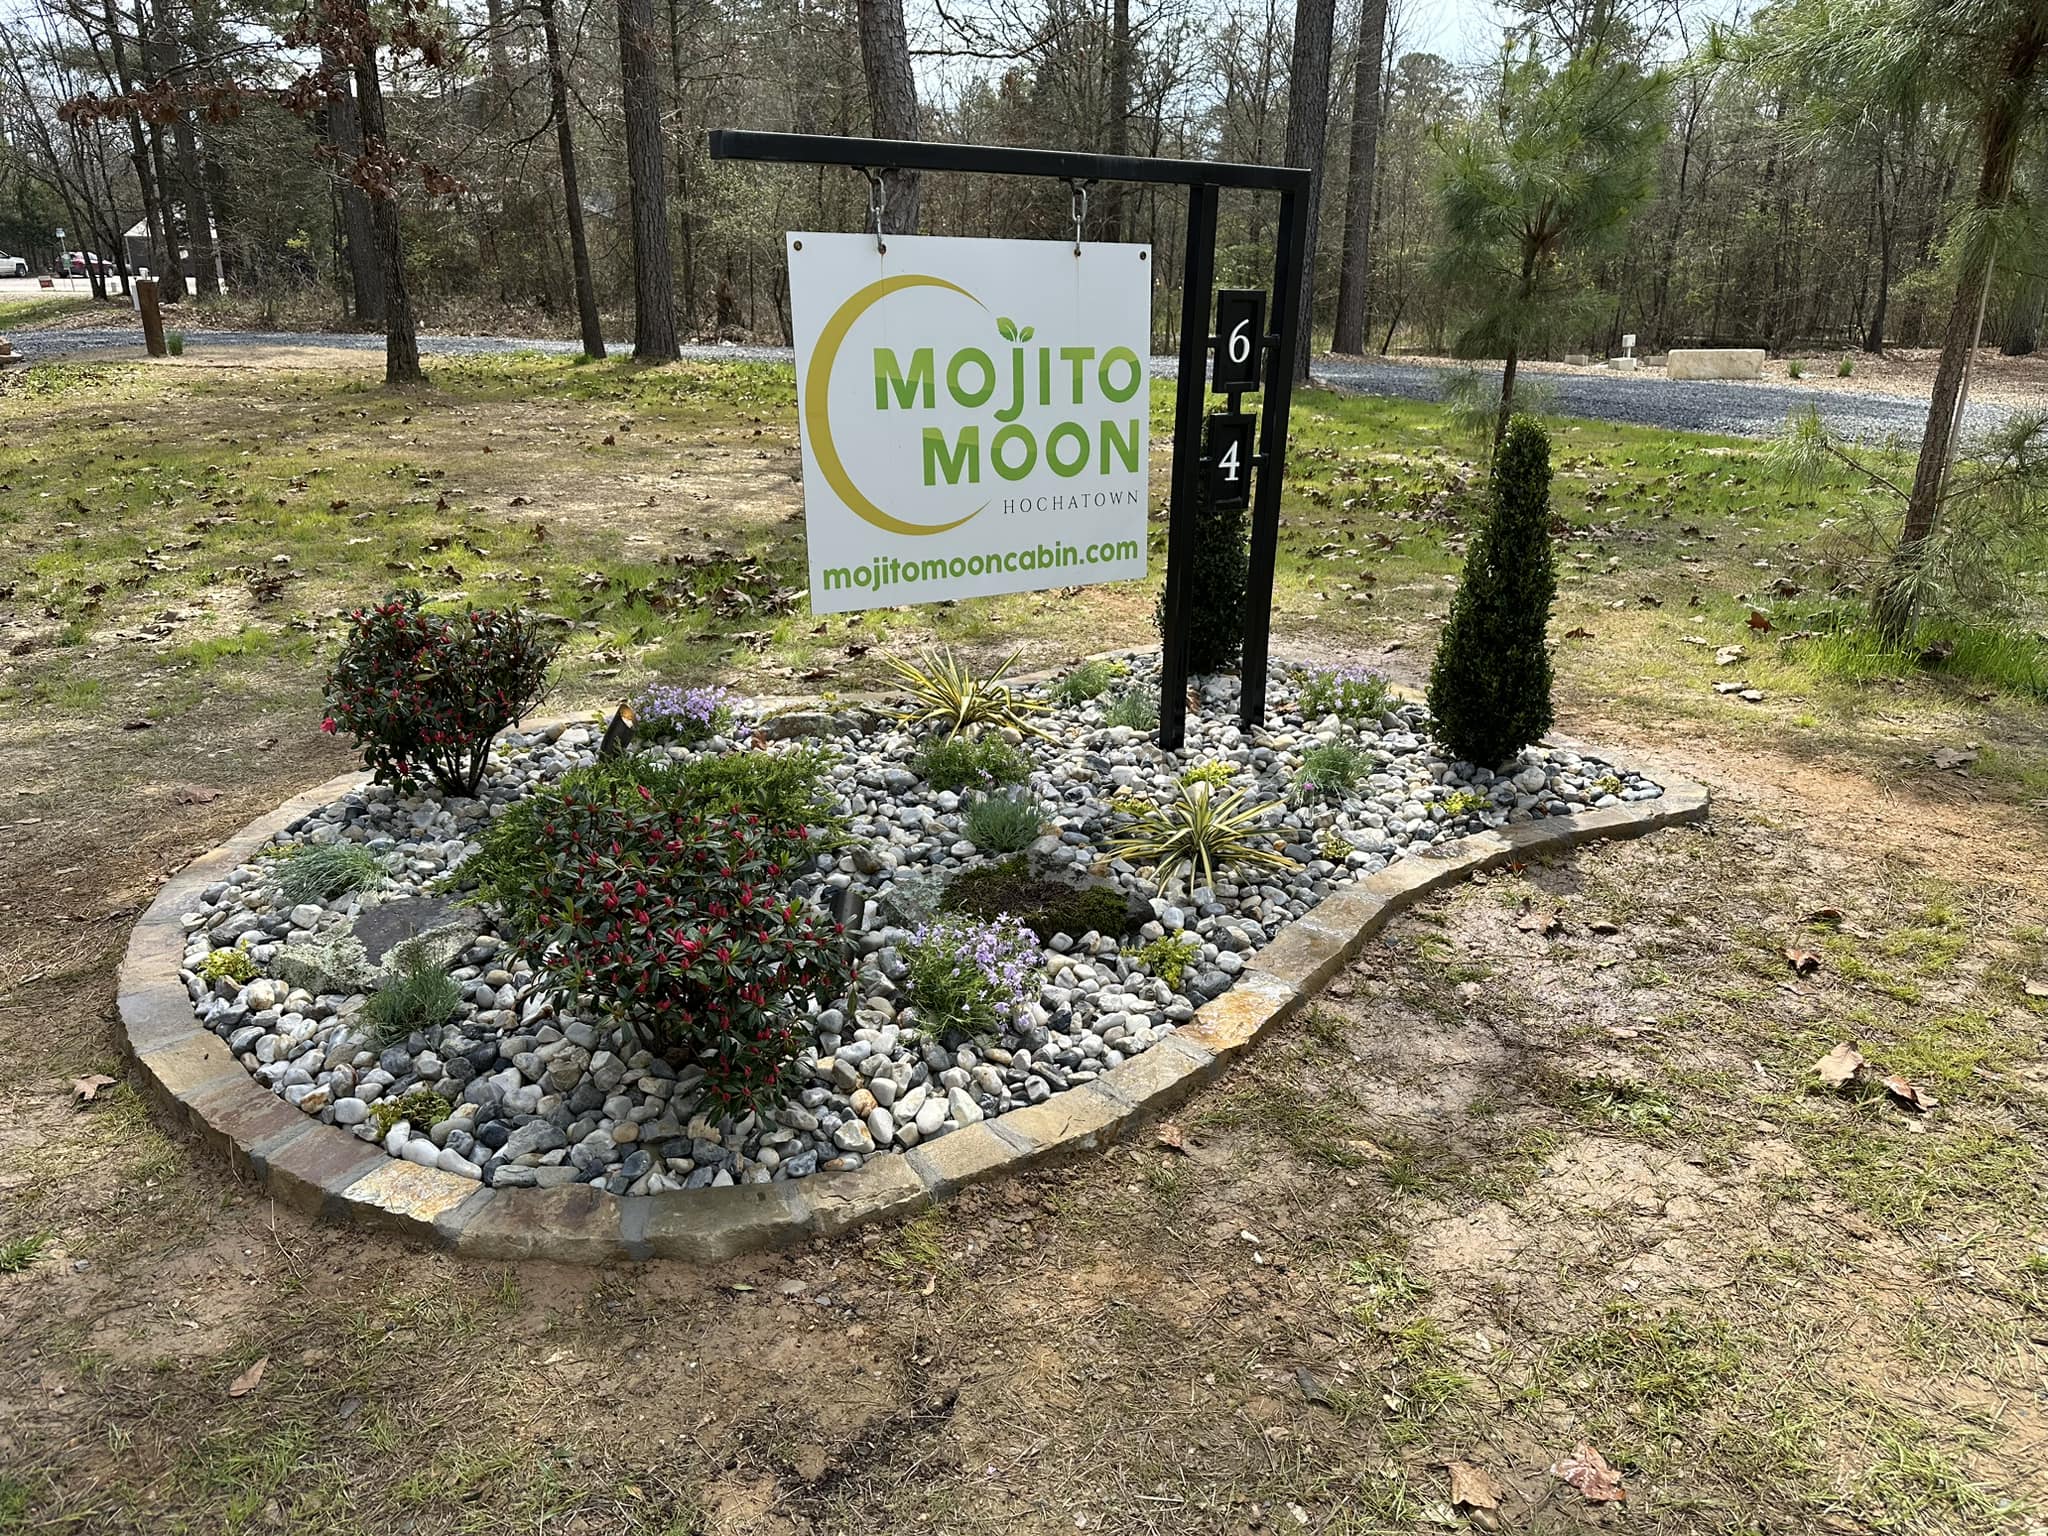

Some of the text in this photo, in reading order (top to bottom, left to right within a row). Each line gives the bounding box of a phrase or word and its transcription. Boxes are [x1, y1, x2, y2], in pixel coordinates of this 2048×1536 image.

[1228, 318, 1251, 364] 6
[873, 346, 1142, 423] MOJITO
[922, 419, 1140, 486] MOON
[1218, 440, 1241, 481] 4
[1003, 490, 1139, 514] HOCHATOWN
[823, 540, 1138, 592] mojitomooncabin.com
